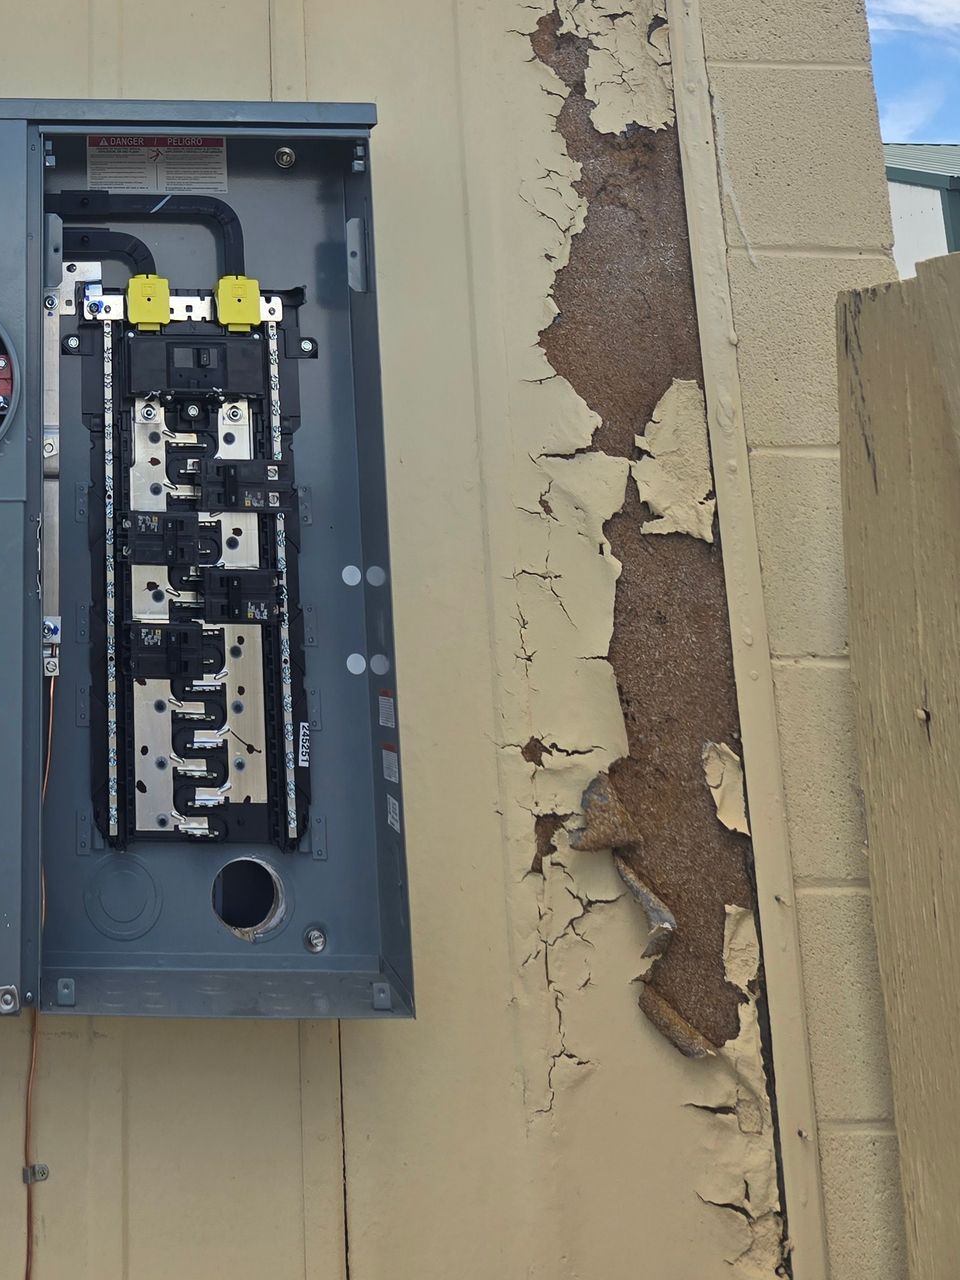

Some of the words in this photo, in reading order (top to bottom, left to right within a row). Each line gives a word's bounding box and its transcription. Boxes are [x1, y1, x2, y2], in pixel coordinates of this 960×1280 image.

[110, 136, 145, 146] DANGER
[167, 137, 203, 146] PELIGRO
[301, 724, 310, 763] 245251
